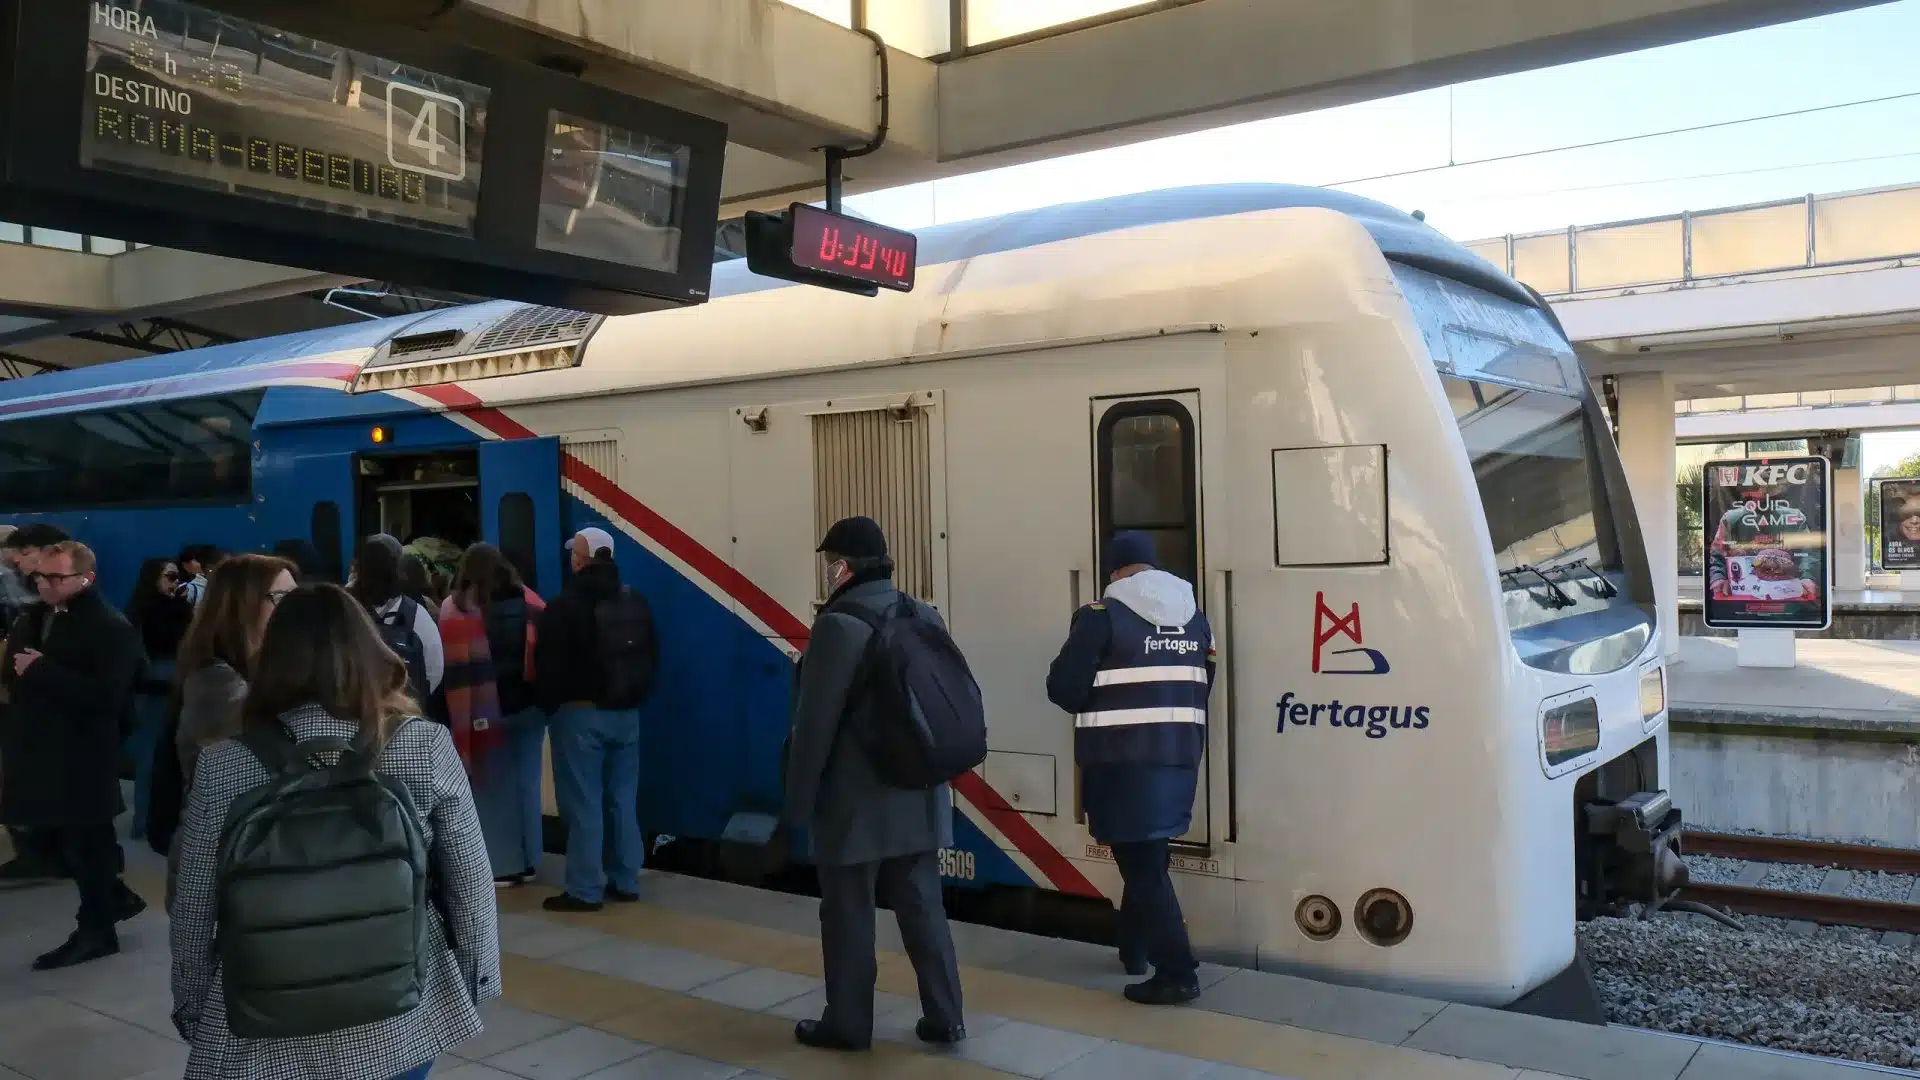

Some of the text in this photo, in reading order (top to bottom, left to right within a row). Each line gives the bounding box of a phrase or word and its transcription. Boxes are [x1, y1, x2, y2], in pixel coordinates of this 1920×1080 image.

[94, 2, 158, 40] HORA
[165, 52, 177, 76] h
[95, 72, 192, 115] DESTINO
[407, 100, 447, 165] 4
[95, 105, 426, 204] ROMA-AREEIRO
[1742, 464, 1808, 487] KFC
[1732, 494, 1790, 513] SQUID
[1742, 512, 1807, 531] GAME
[1144, 636, 1199, 655] fertagus
[1276, 691, 1430, 739] fertagus
[937, 847, 975, 880] 3509
[1088, 847, 1108, 858] FREIO
